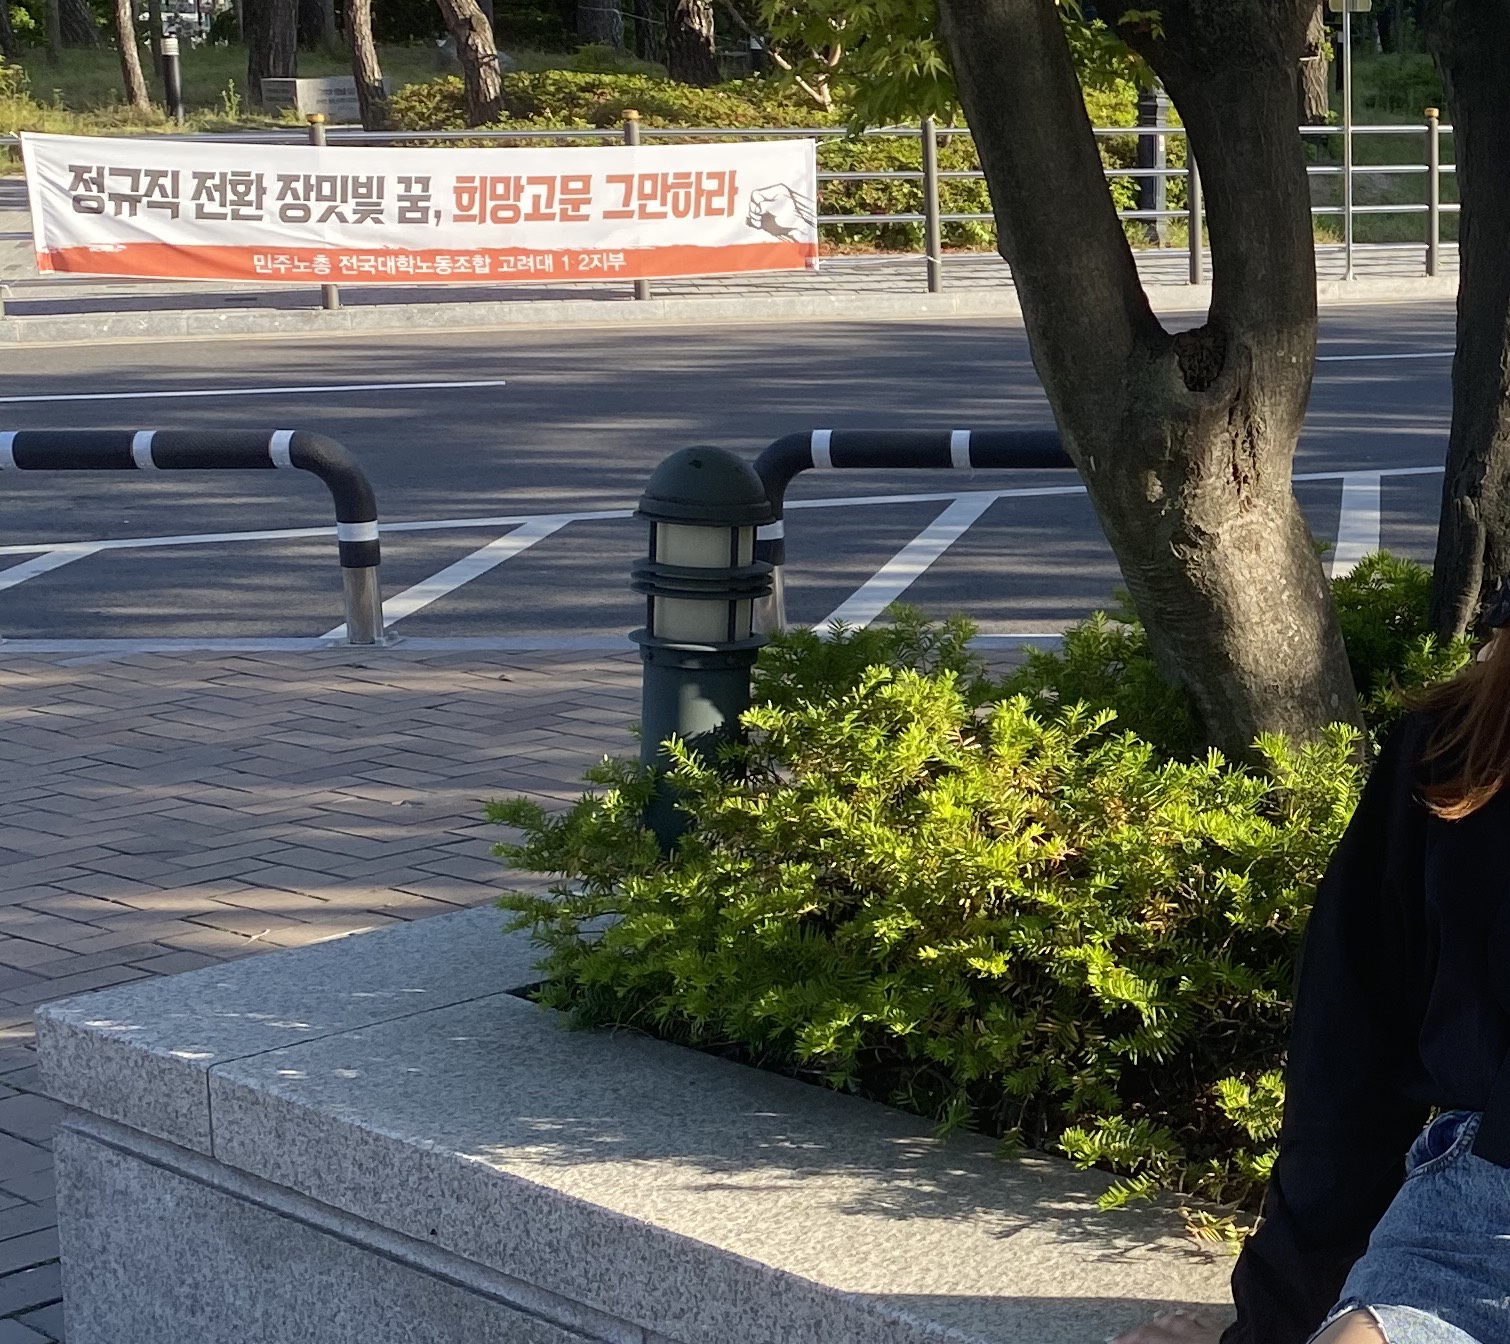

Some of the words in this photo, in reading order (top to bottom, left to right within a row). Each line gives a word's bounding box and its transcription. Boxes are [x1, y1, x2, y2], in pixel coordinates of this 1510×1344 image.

[67, 164, 181, 221] 정규직
[191, 170, 267, 222] 전환
[275, 173, 386, 224] 장밋빛
[396, 175, 442, 227] 꿈,
[452, 174, 592, 226] 희망고문
[602, 169, 739, 221] 그만하라
[252, 253, 332, 274] 민주노총
[338, 253, 492, 275] 전국대학노동조합
[497, 253, 554, 273] 고려대
